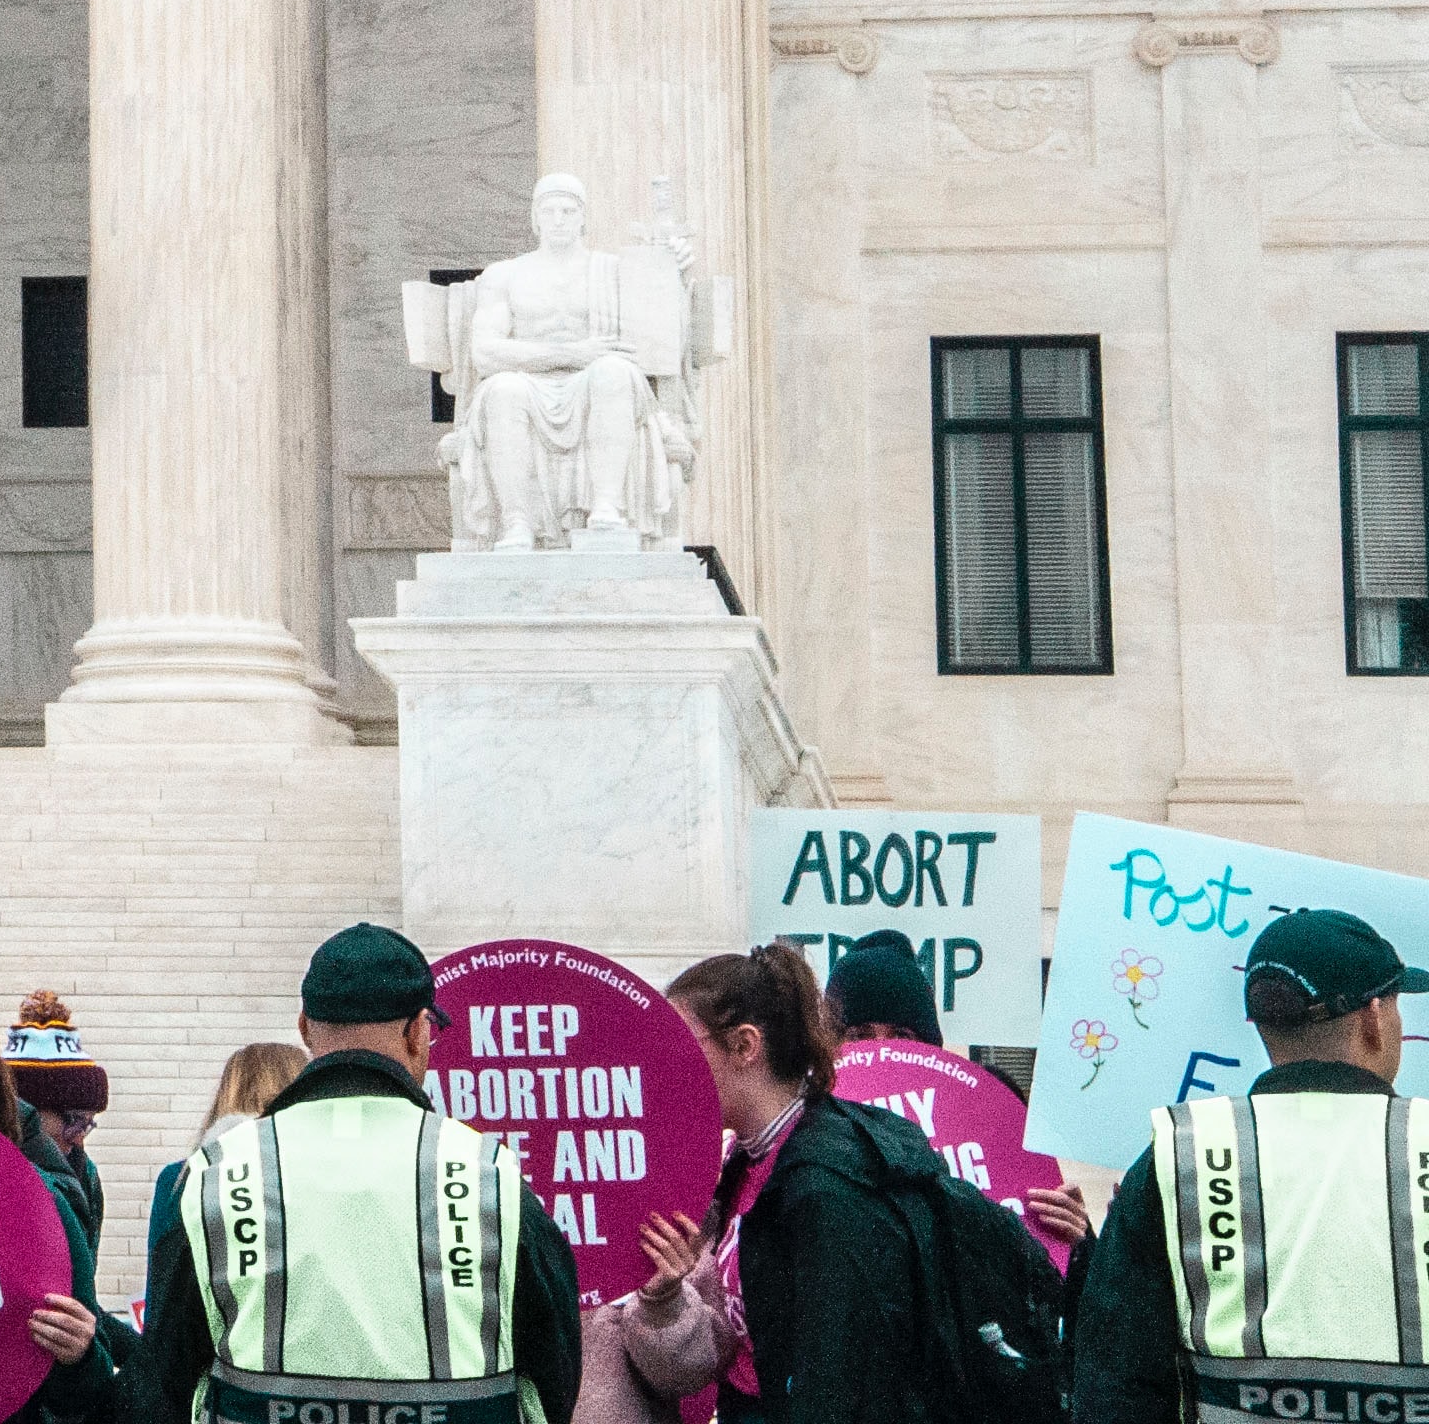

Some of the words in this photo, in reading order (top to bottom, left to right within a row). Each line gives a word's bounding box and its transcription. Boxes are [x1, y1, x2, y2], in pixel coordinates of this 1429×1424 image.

[781, 830, 997, 908] ABORT
[1108, 848, 1253, 939] Post
[470, 948, 550, 971] Majority
[554, 950, 651, 1010] Foundation
[468, 1004, 580, 1058] KEEP
[424, 1066, 644, 1121] ABORTION
[834, 1049, 875, 1067] ority
[879, 1047, 979, 1089] Foundation
[553, 1129, 648, 1183] AND
[227, 1162, 259, 1277] USCP
[444, 1161, 474, 1288] POLICE
[1205, 1148, 1236, 1272] USCP
[267, 1400, 449, 1424] POLICE
[1238, 1383, 1429, 1424] POLICE
